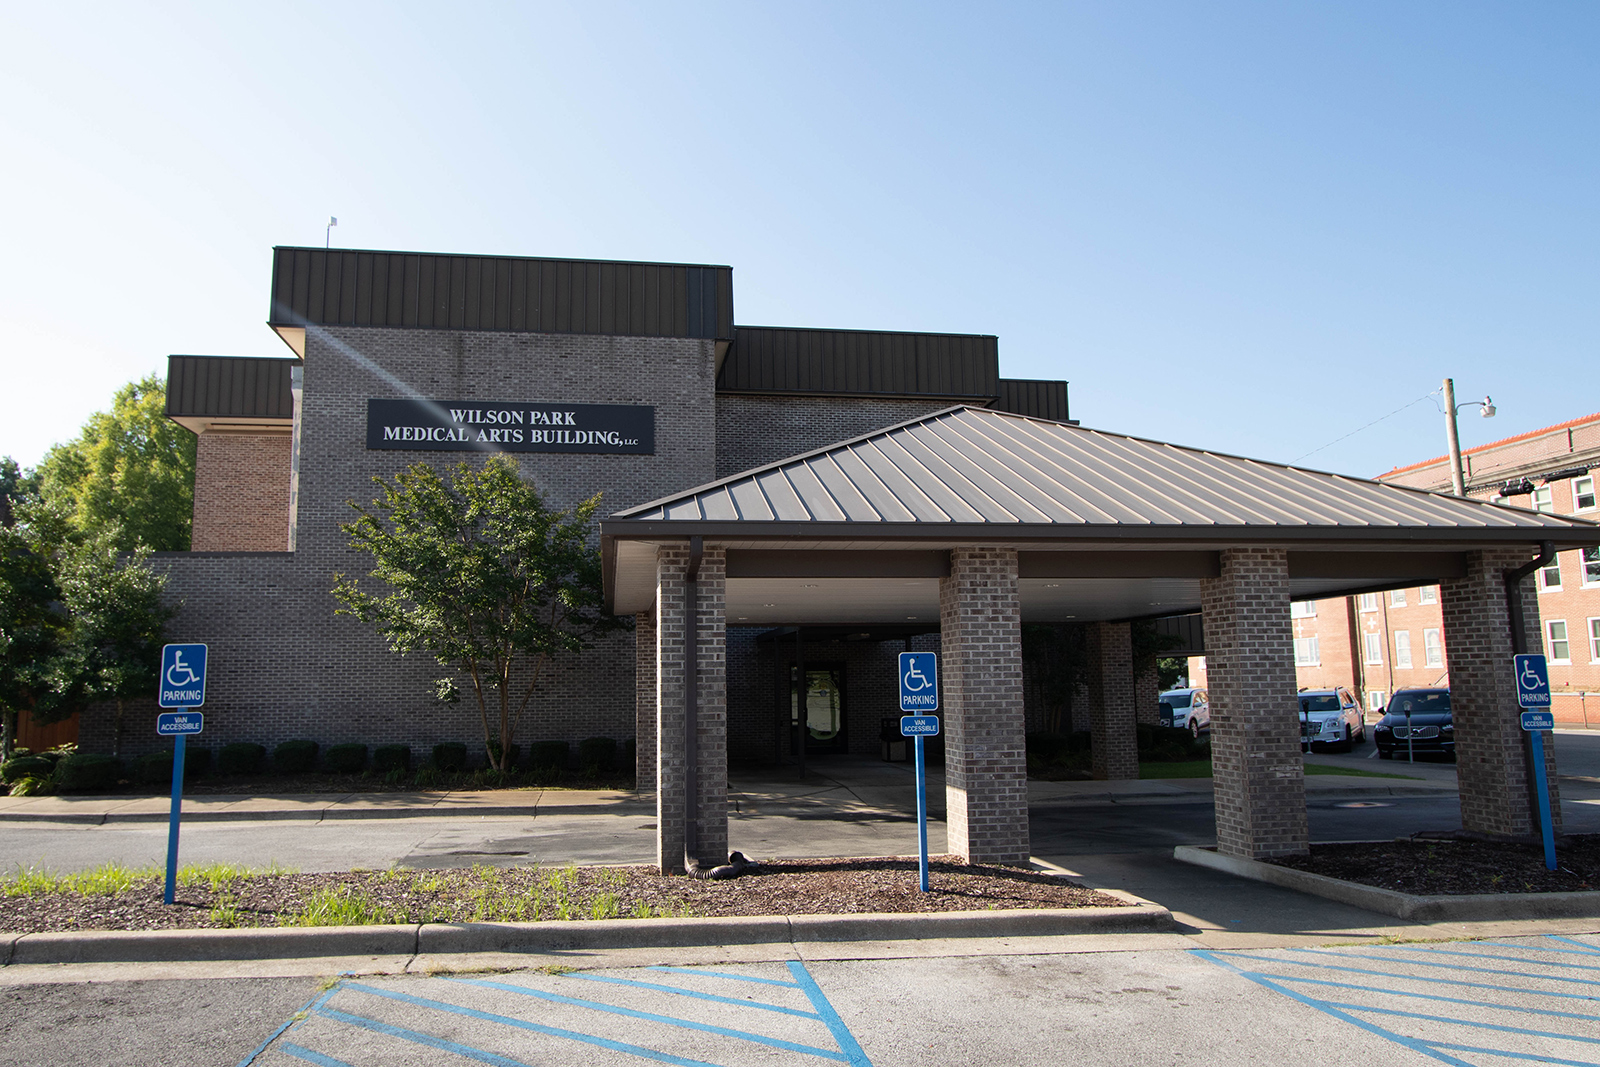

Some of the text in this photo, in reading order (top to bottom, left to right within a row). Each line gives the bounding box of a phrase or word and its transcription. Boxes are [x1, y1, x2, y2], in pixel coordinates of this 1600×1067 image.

[450, 409, 576, 426] WILSON PARK
[383, 426, 469, 442] MEDICAL
[476, 428, 523, 443] ARTS
[163, 690, 201, 701] PARKING
[903, 695, 935, 705] PARKING
[1521, 693, 1549, 703] PARKING
[160, 722, 200, 731] ACCESSIBLE
